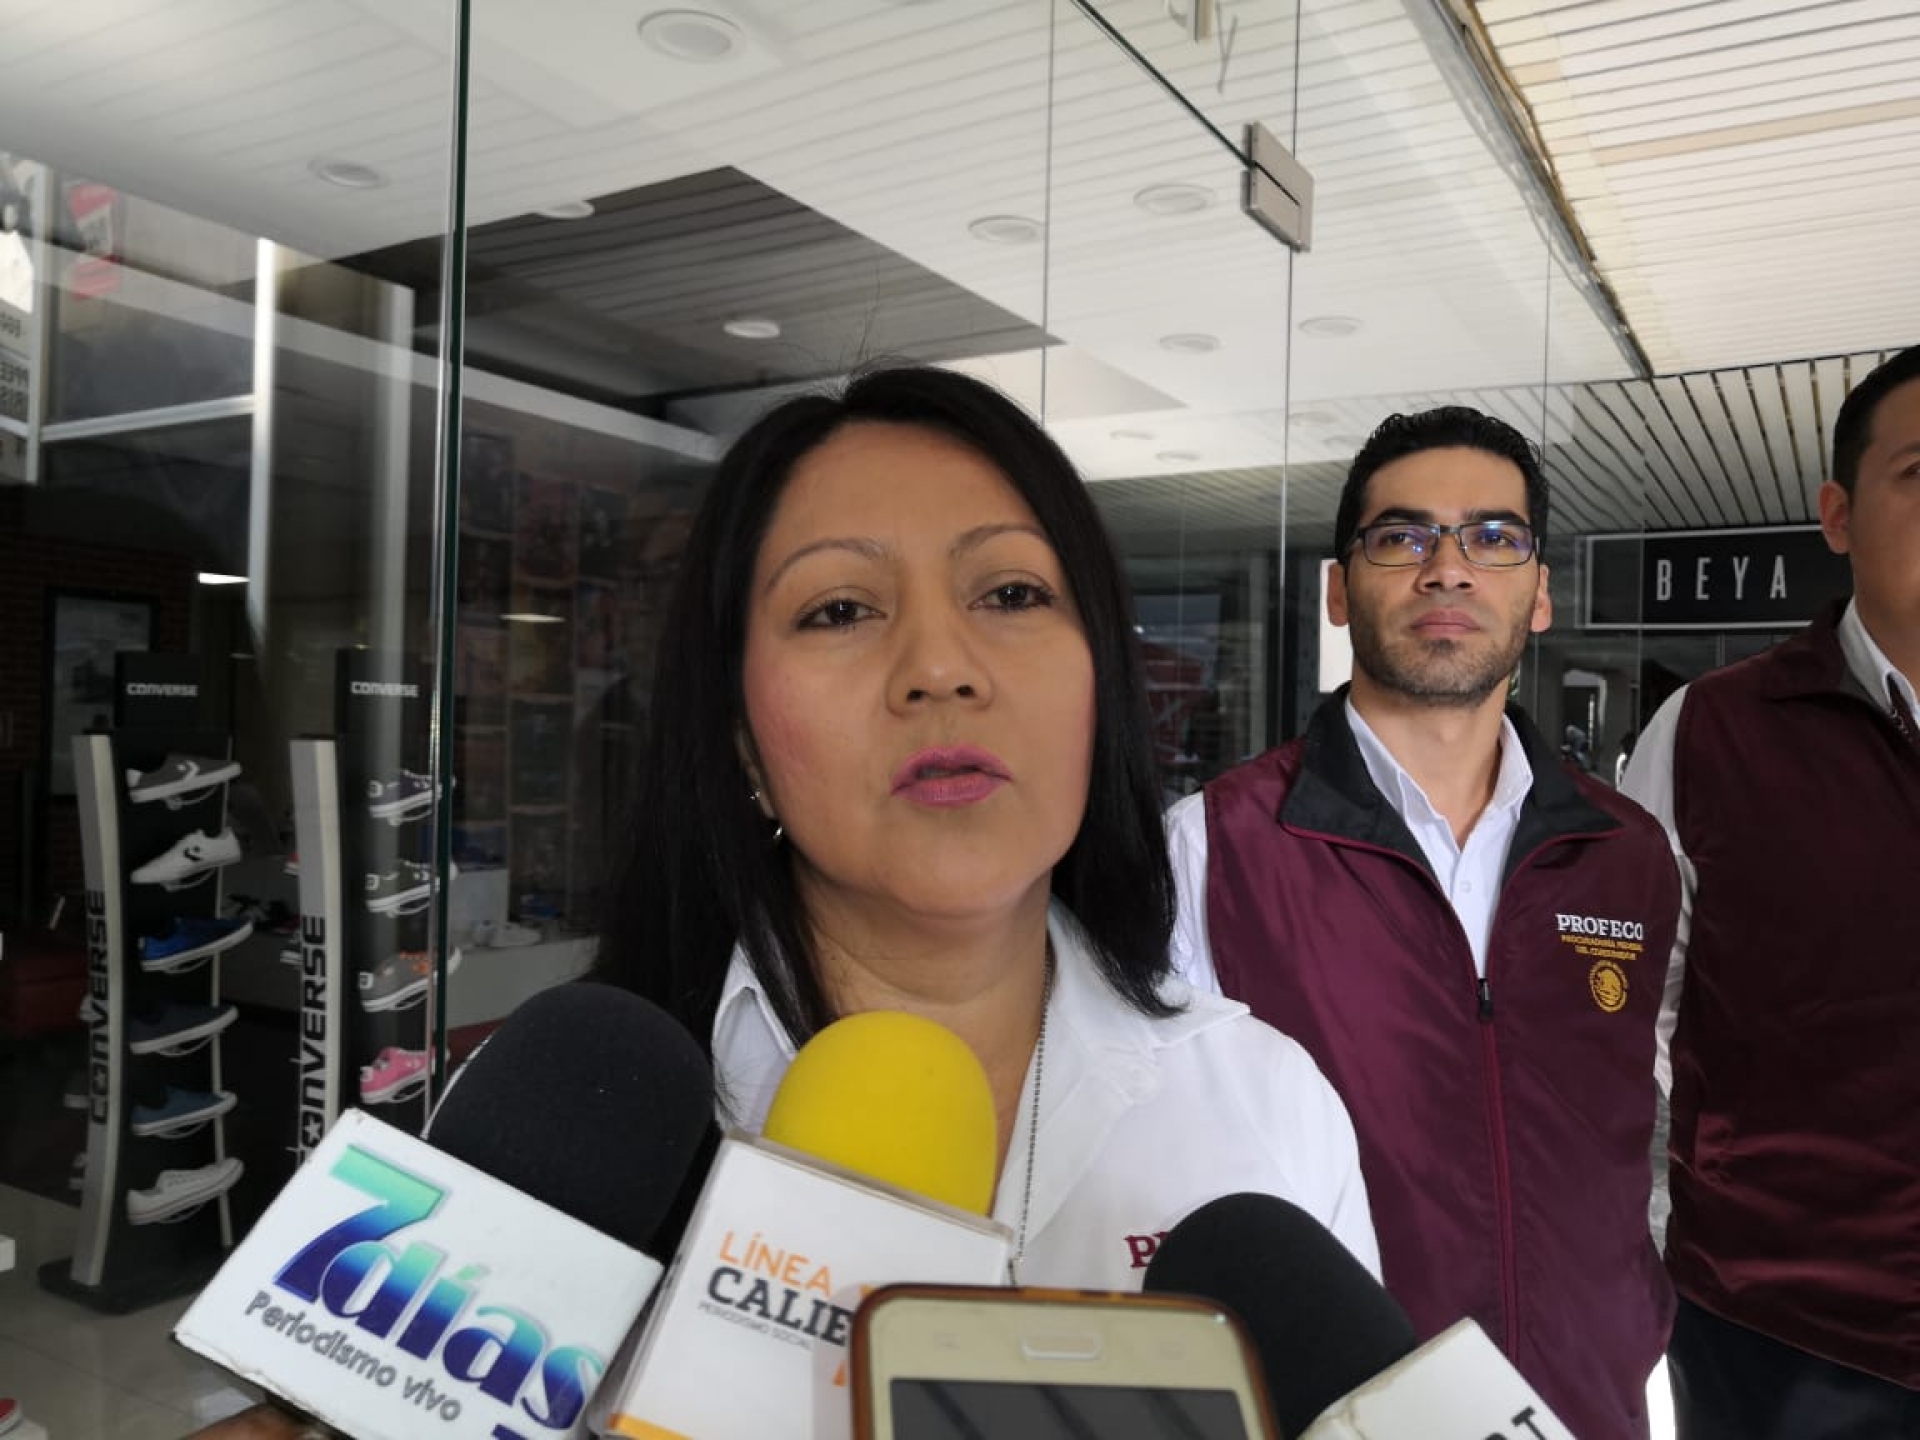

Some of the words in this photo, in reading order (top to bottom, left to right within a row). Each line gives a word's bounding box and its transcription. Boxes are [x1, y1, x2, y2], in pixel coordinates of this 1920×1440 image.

[1656, 555, 1786, 600] BEYA
[127, 683, 198, 696] CONVERSE
[1555, 914, 1644, 940] PROFECO
[87, 890, 109, 1125] CONVERSE
[302, 916, 325, 1161] ONVERSE
[719, 1230, 832, 1297] LÍNEA
[246, 1291, 396, 1388] Periodismo
[404, 1374, 463, 1422] vivo
